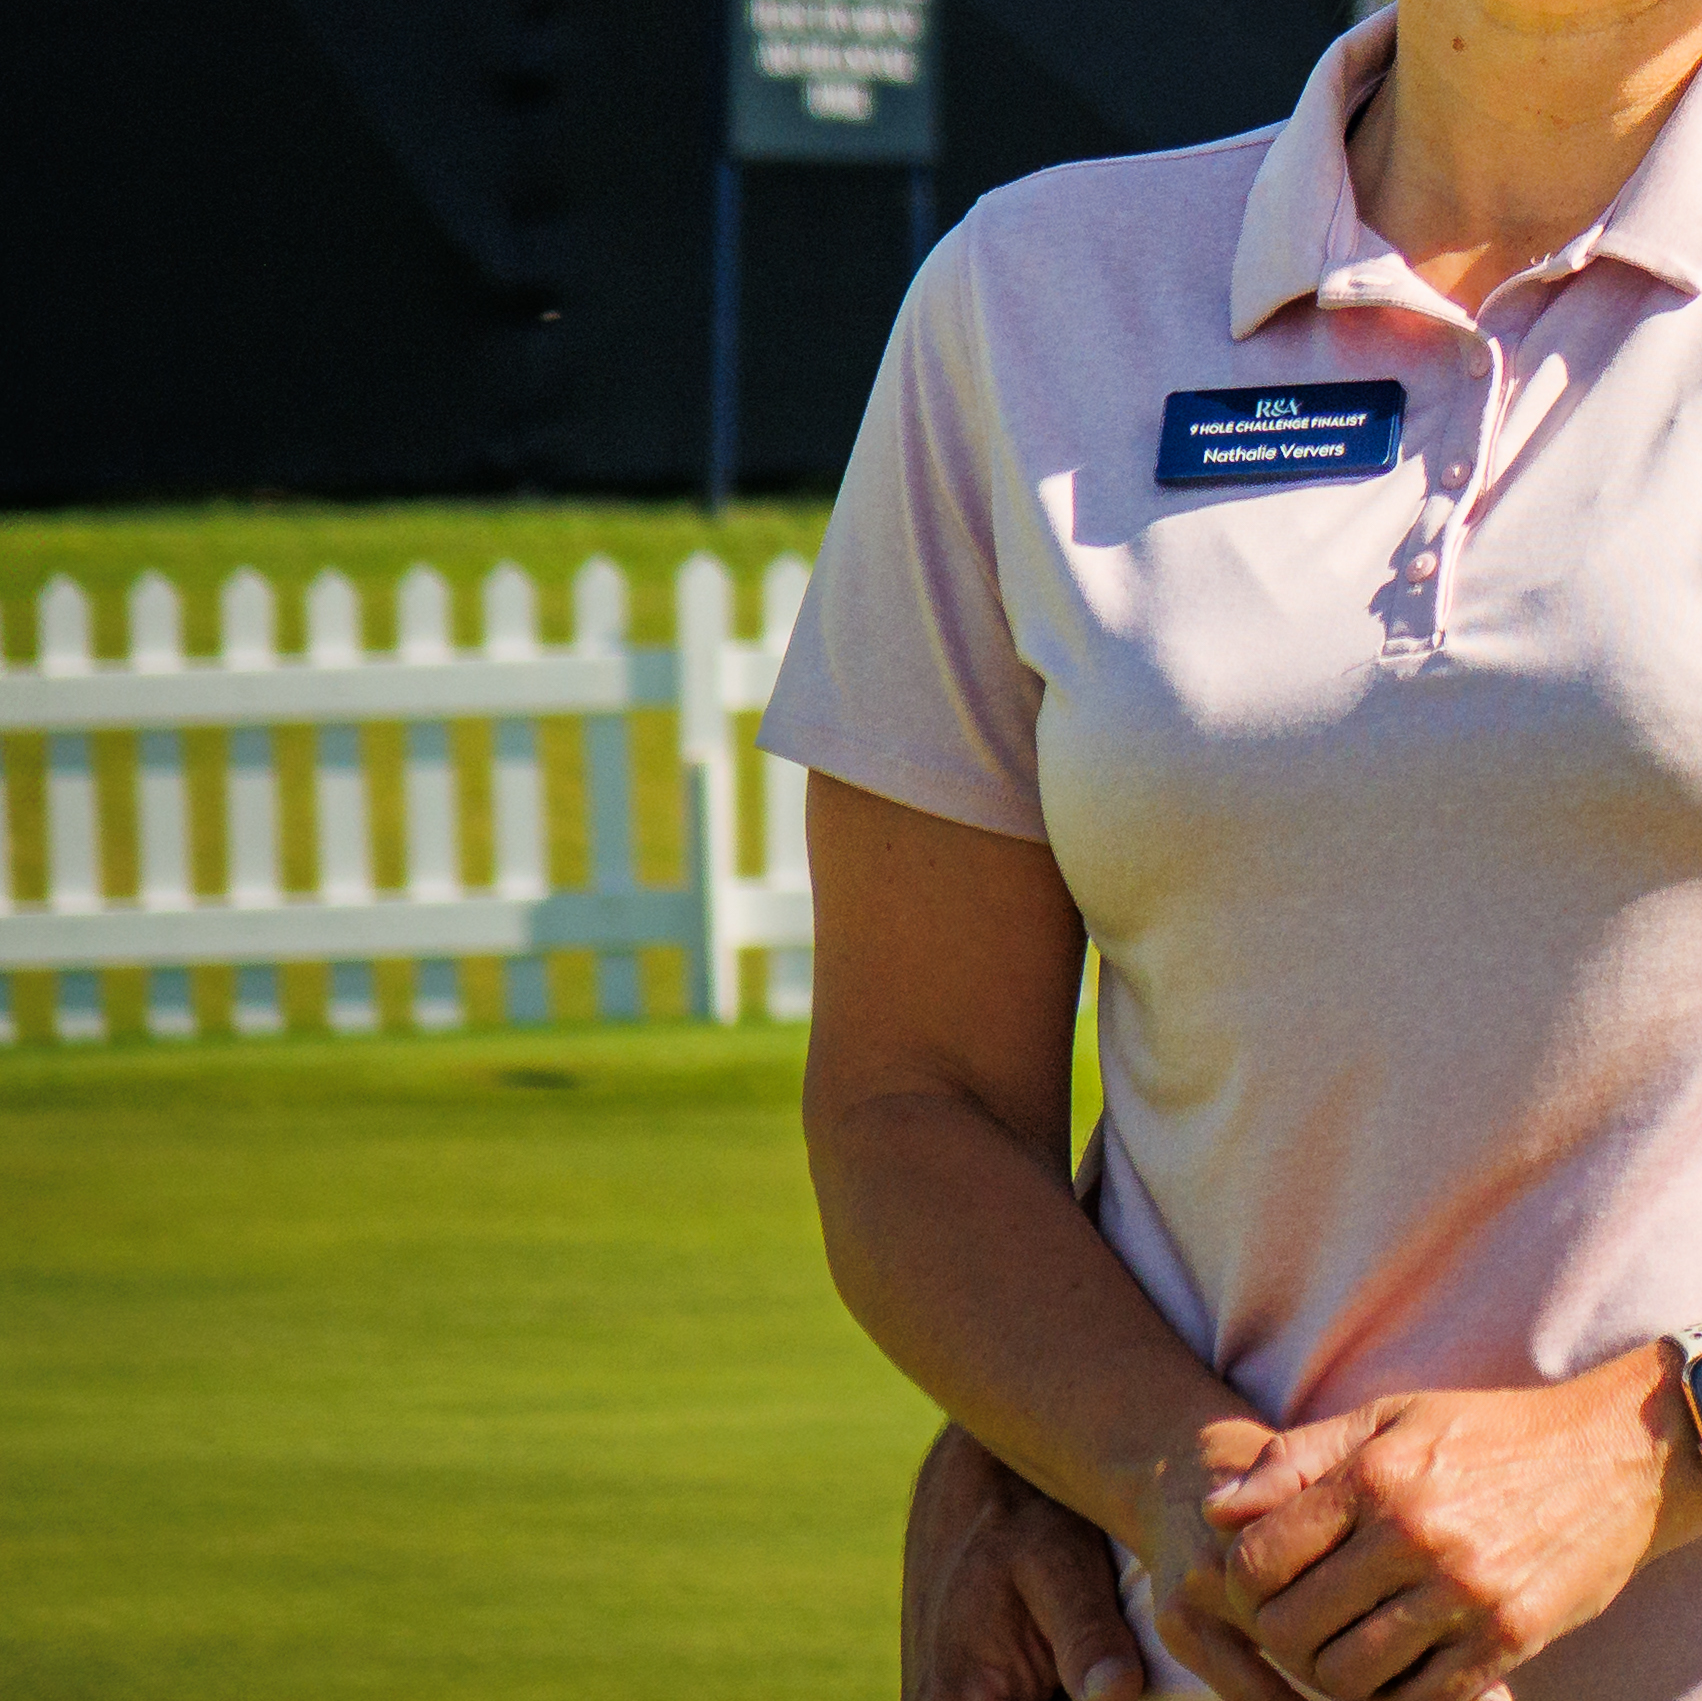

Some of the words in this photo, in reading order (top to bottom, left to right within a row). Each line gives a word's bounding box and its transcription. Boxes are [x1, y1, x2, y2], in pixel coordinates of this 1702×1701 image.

[1256, 398, 1301, 418] R&A
[1190, 424, 1199, 435] 9
[1199, 421, 1234, 435] HOLE
[1235, 417, 1309, 433] CHALLENGE
[1311, 413, 1366, 428] FINALIST
[1202, 444, 1277, 464] Nathalie
[1279, 442, 1345, 459] Ververs
